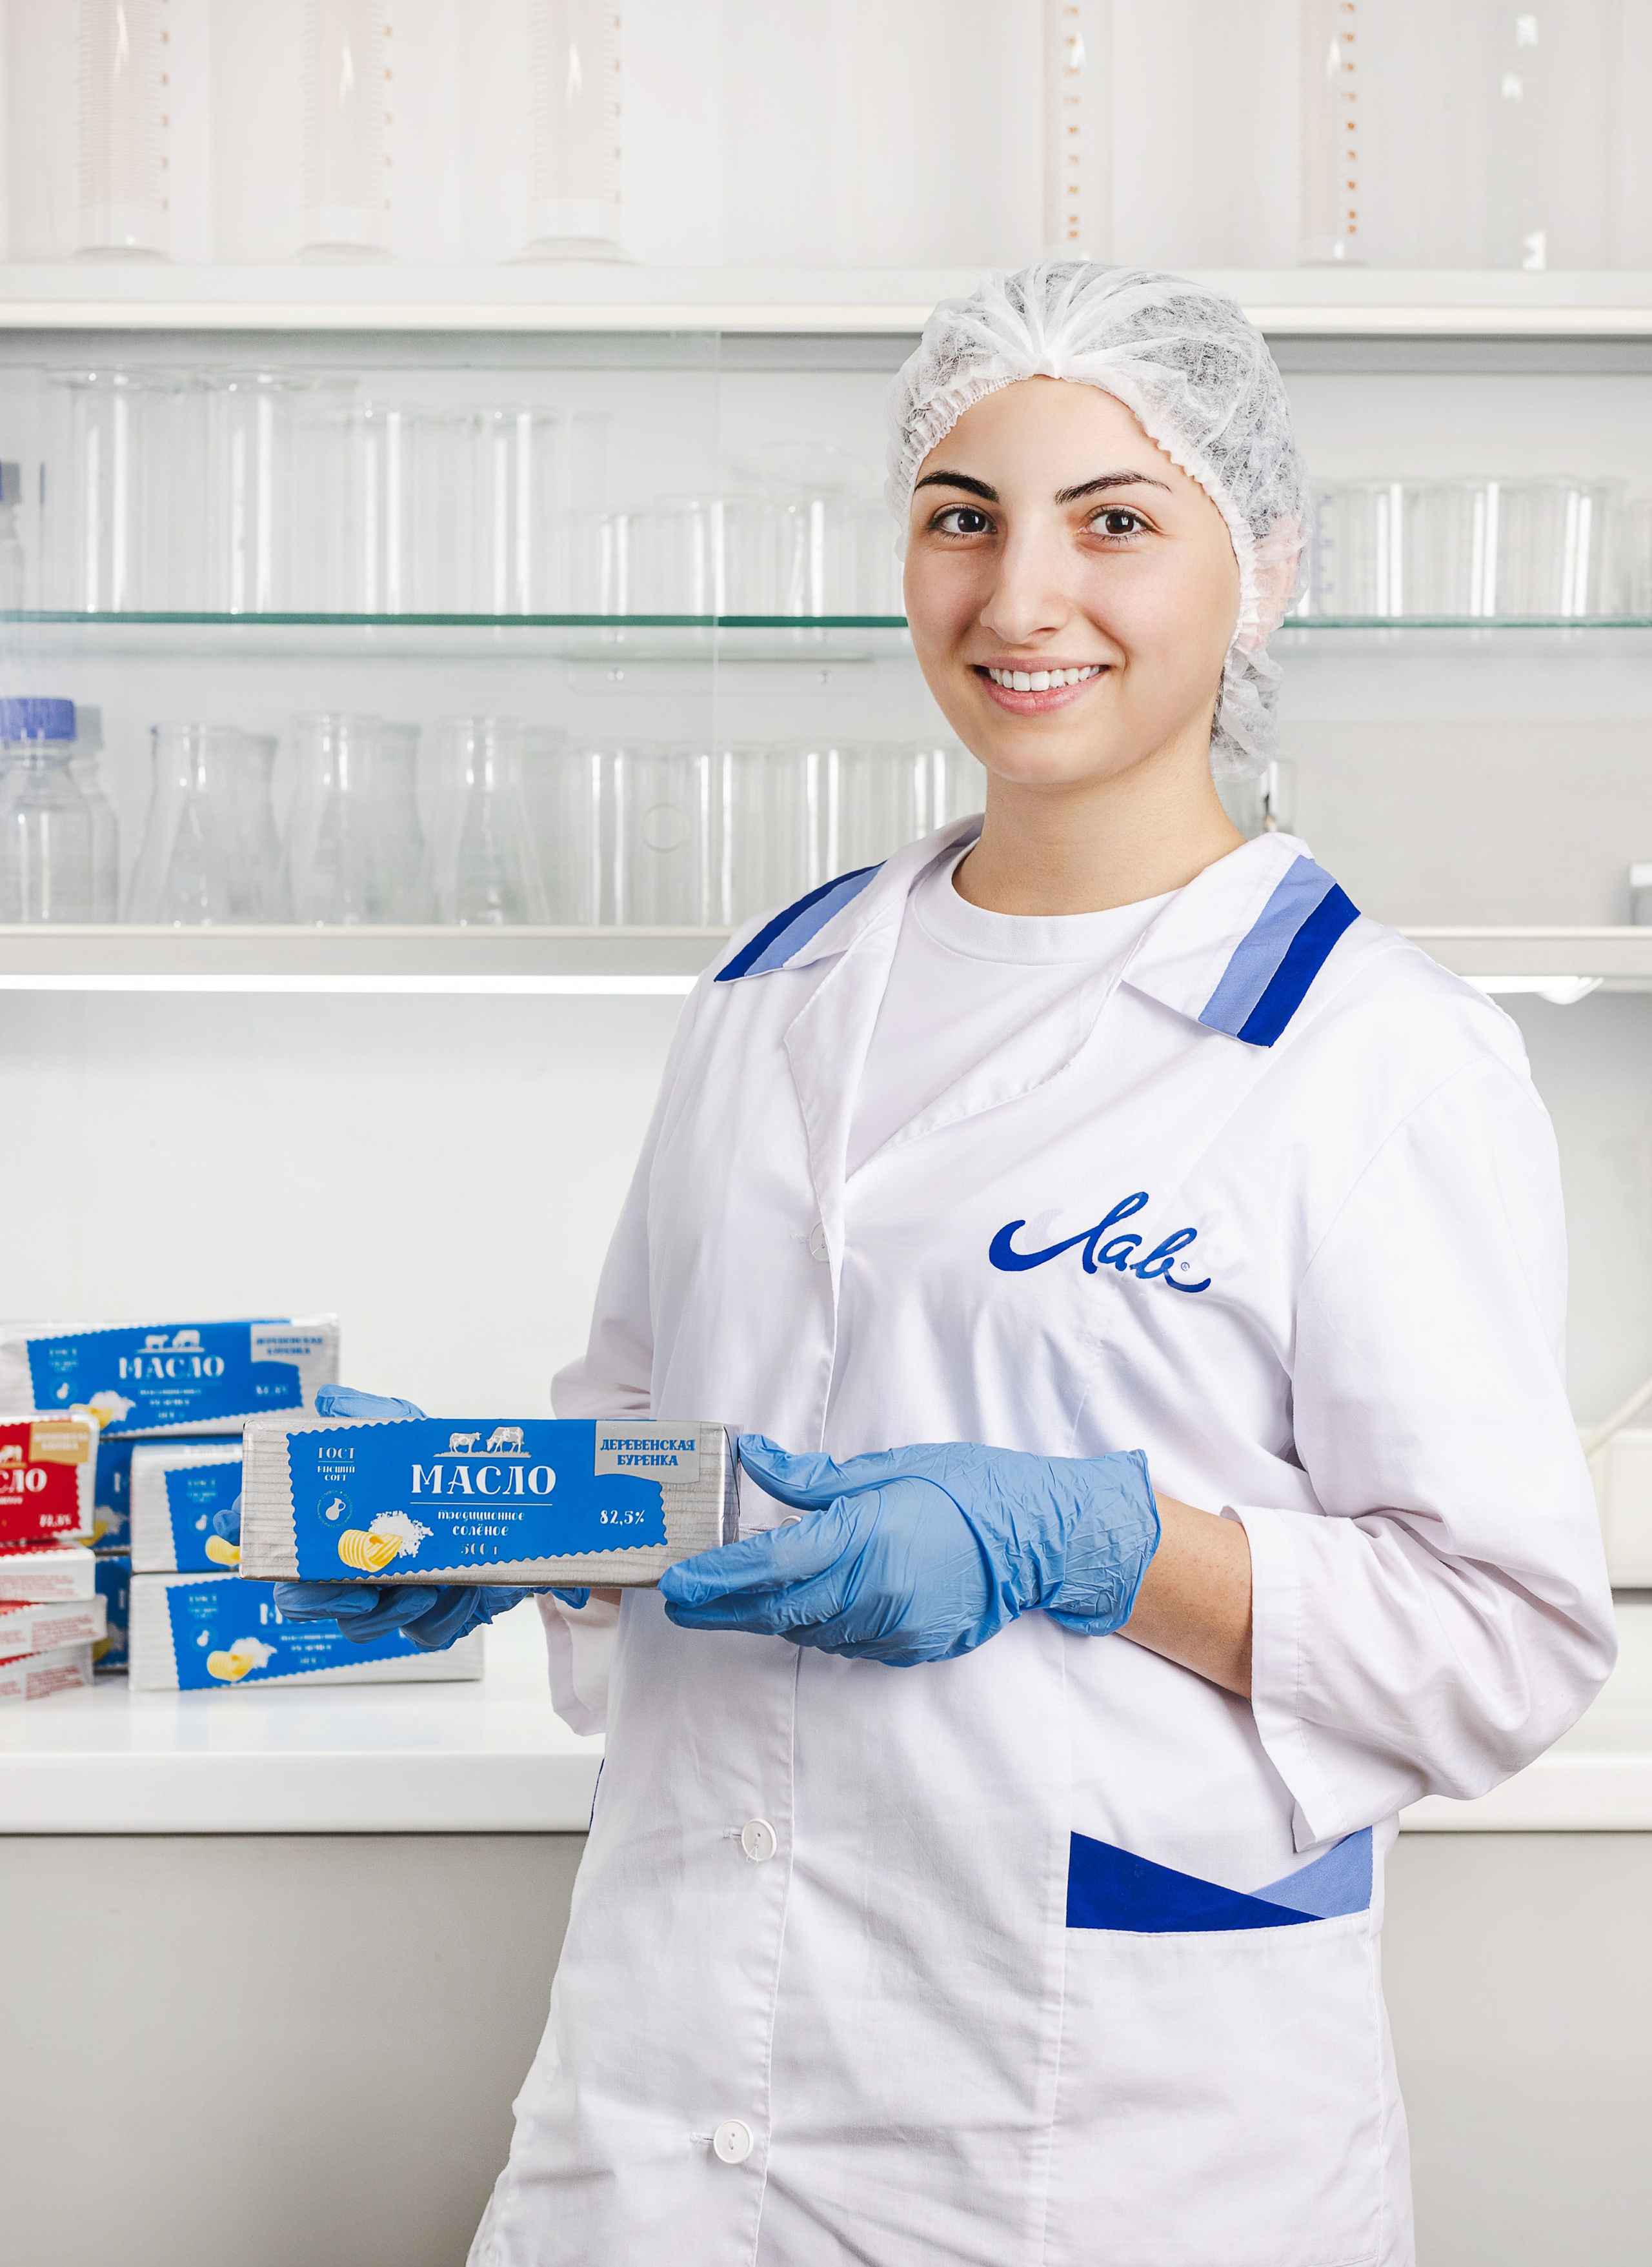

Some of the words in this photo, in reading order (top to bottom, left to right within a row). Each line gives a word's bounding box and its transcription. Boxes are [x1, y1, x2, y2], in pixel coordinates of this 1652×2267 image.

[118, 1356, 225, 1379] МАСЛО
[600, 1439, 696, 1451] ДЕРЕВЕНСКАЯ
[317, 1447, 356, 1459] ГОСТ
[617, 1455, 678, 1466] БУРЕНКА
[317, 1465, 355, 1473] ВЫСШИЙ
[411, 1464, 556, 1495] МАСЛО
[438, 1509, 525, 1522] традиционное
[599, 1509, 645, 1526] 82,5%
[452, 1524, 509, 1537] солёное
[461, 1542, 489, 1555] 500
